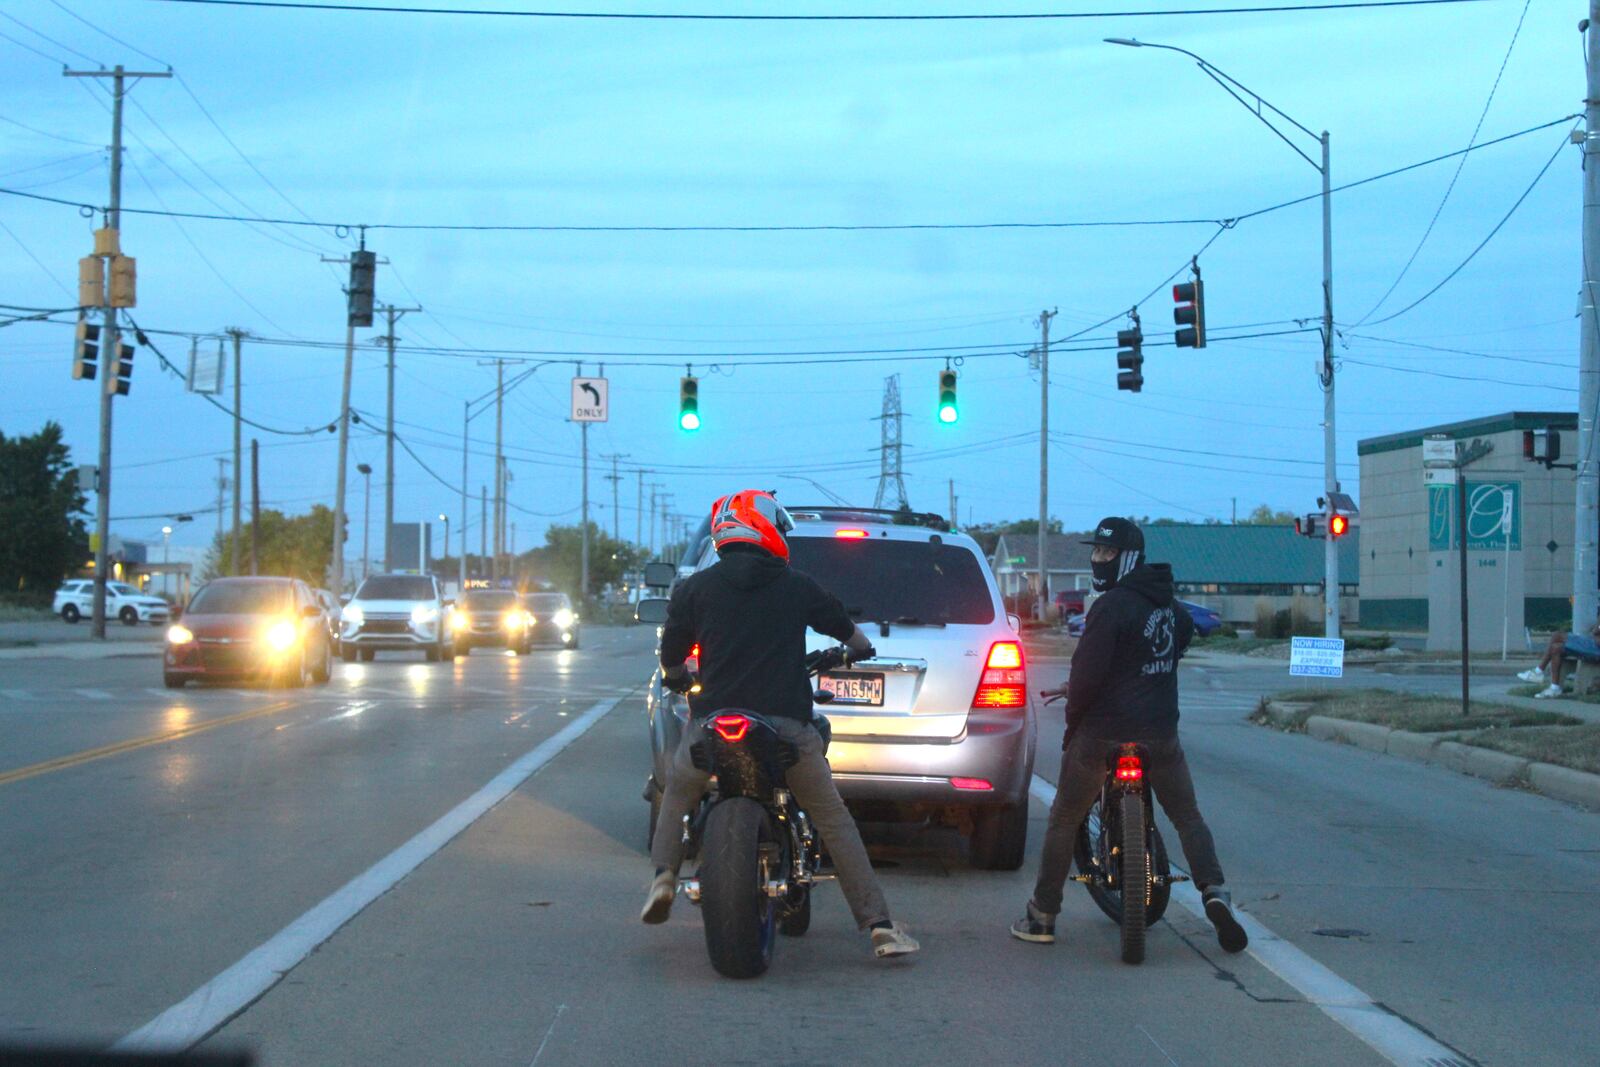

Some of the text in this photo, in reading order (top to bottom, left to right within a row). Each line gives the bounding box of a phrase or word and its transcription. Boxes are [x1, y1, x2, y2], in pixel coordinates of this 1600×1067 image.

[576, 408, 603, 417] ONLY
[1294, 639, 1342, 650] NOW HIRING
